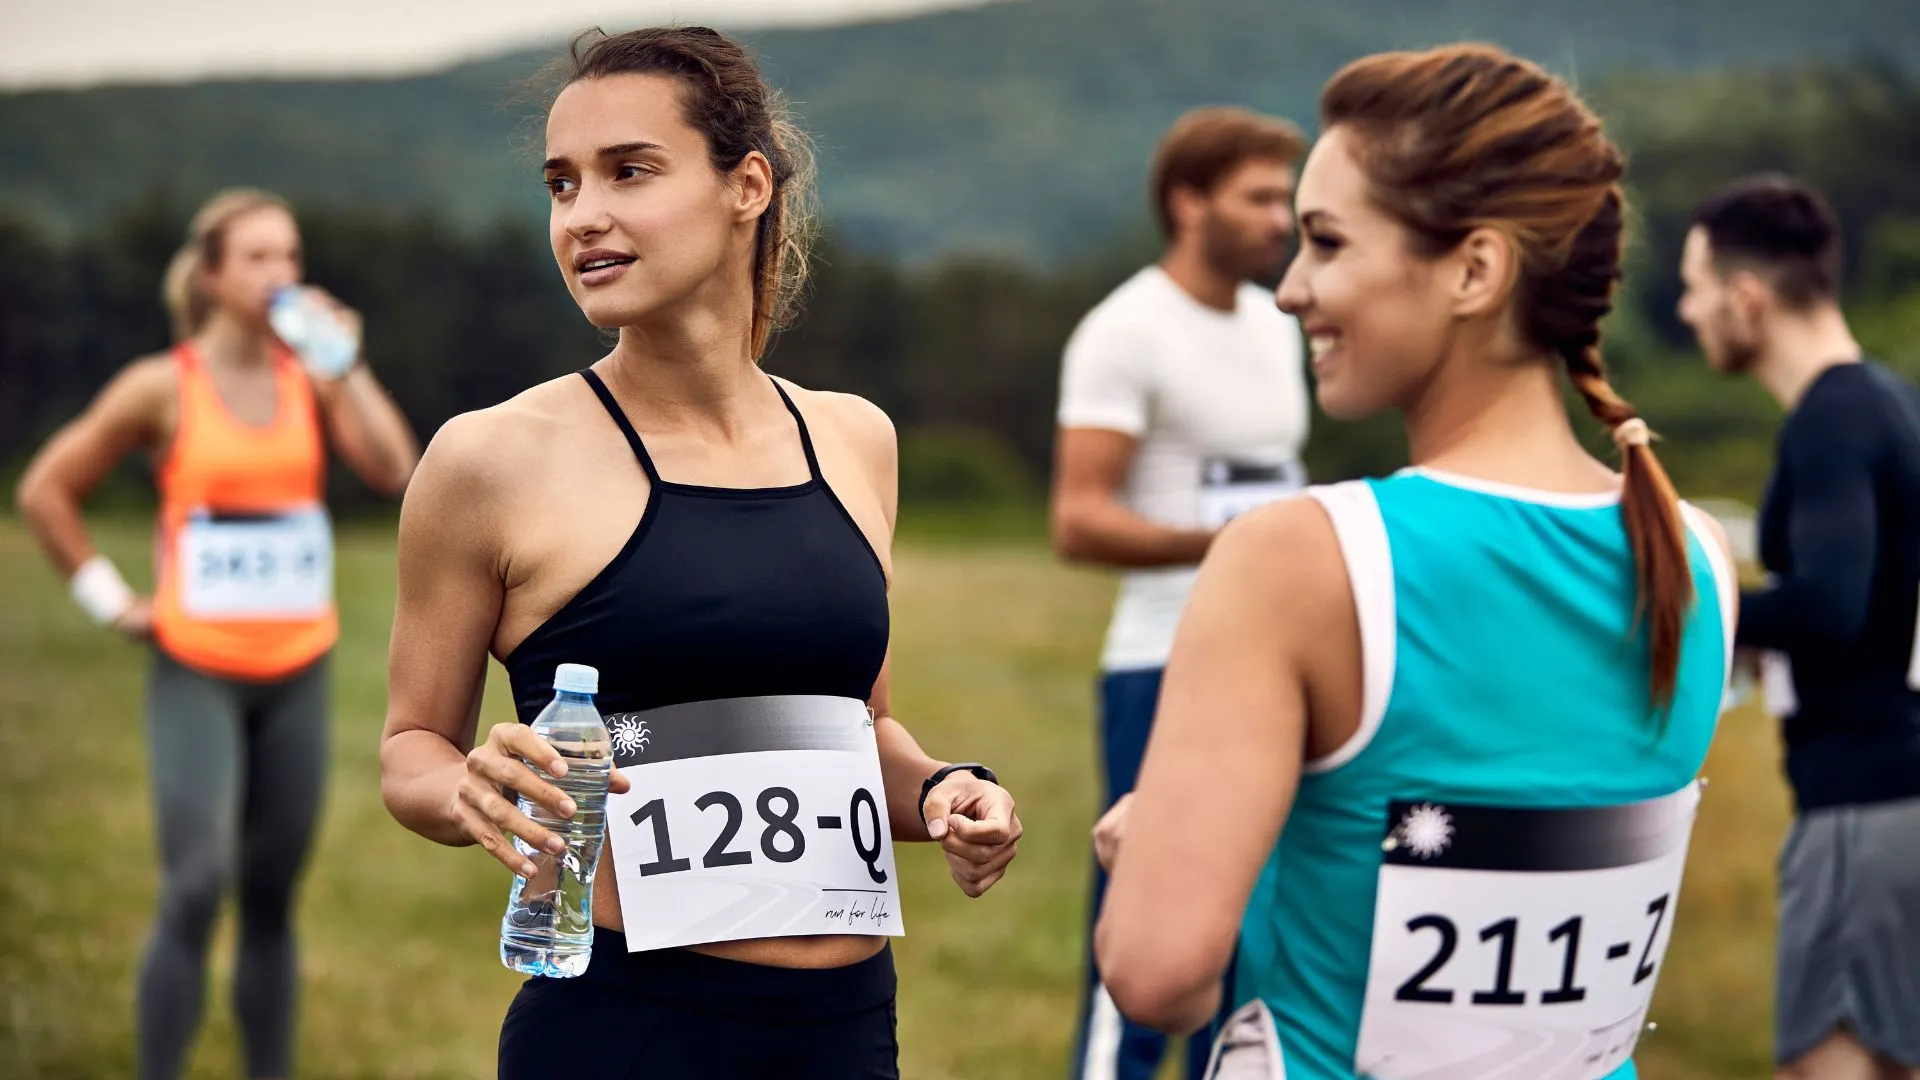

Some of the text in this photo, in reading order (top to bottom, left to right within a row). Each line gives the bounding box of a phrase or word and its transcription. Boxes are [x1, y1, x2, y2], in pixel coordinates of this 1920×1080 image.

[630, 786, 887, 884] 128-Q
[825, 896, 890, 926] run for life
[1394, 892, 1670, 1006] 211-Z
